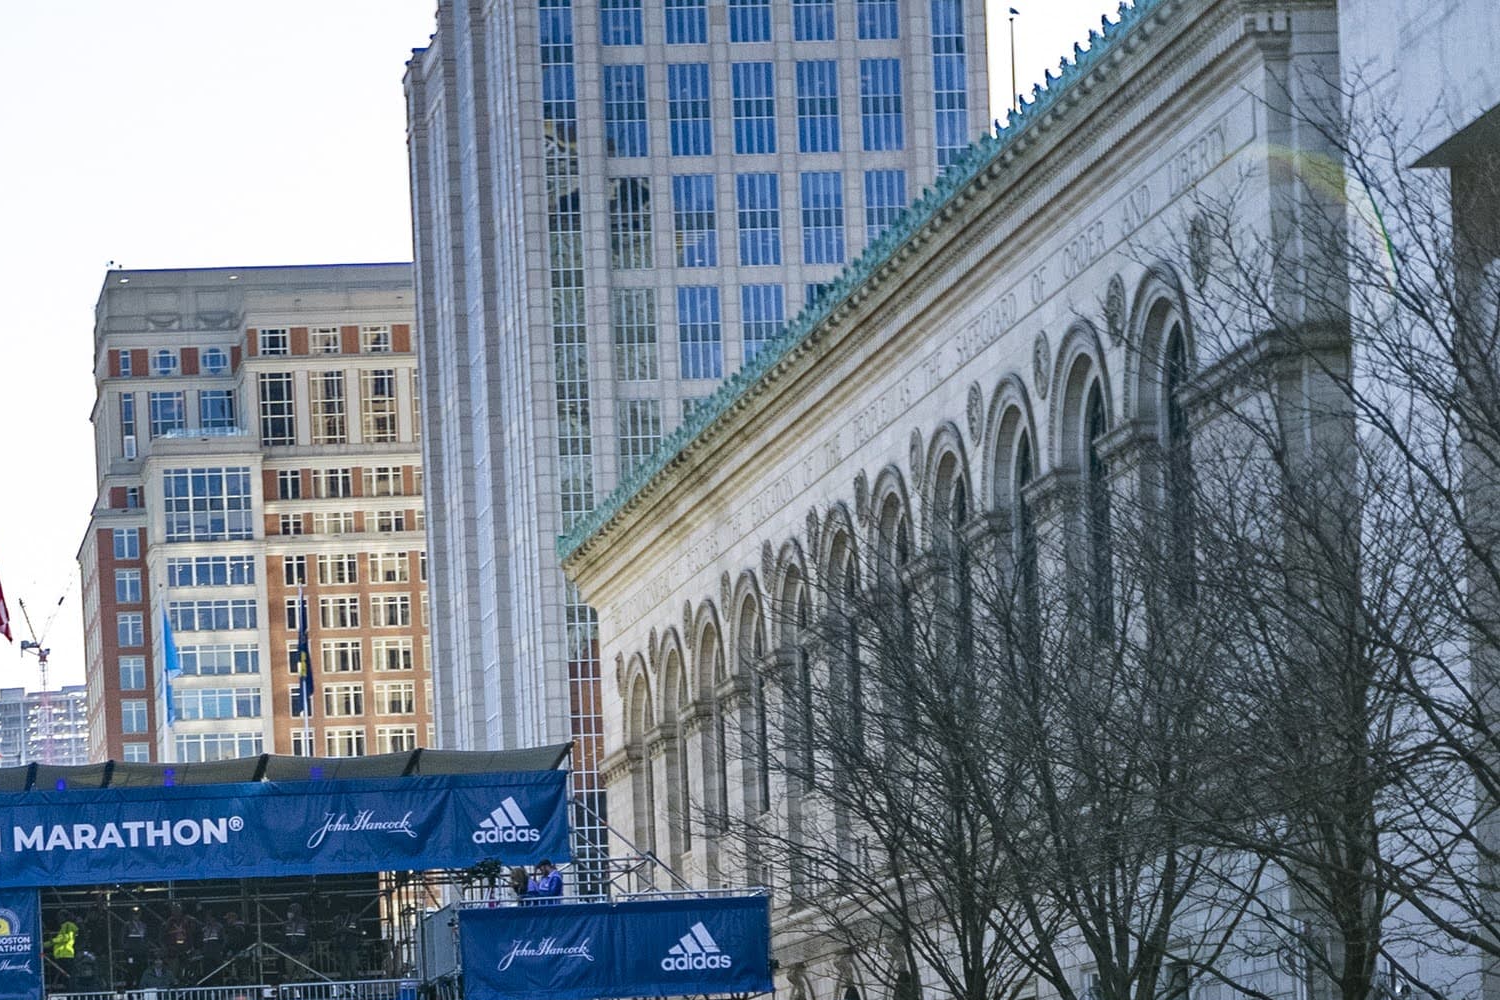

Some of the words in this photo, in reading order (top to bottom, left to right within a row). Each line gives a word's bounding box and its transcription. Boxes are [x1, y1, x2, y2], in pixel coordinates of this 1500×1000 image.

[306, 813, 351, 849] John
[349, 809, 417, 838] Hancock
[472, 826, 541, 845] adidas
[497, 940, 537, 971] John
[535, 937, 594, 962] Hancock
[661, 952, 733, 971] adidas
